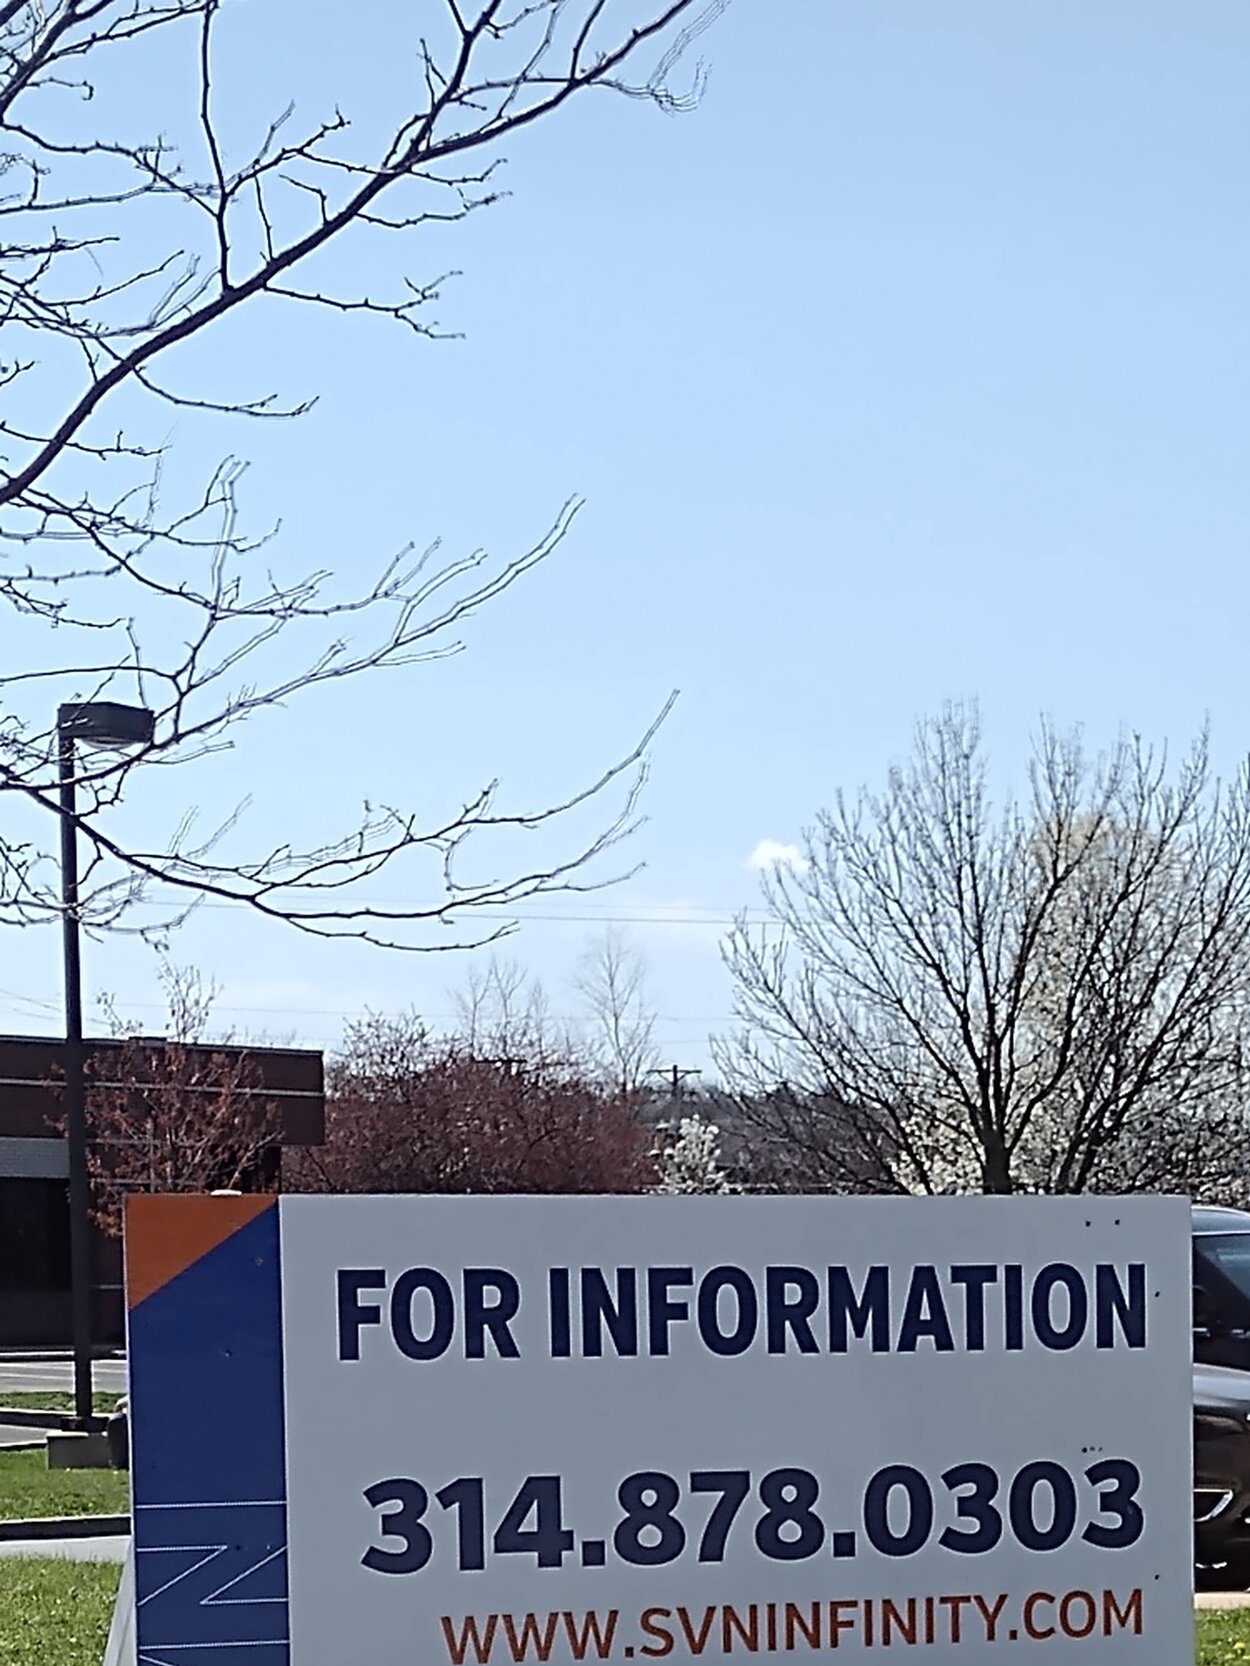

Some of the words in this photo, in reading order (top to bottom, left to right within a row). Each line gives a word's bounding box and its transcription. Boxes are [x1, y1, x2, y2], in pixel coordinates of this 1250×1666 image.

[337, 1267, 521, 1361] FOR
[549, 1262, 1146, 1358] INFORMATION
[360, 1459, 1144, 1575] 314.878.0303
[440, 1587, 1143, 1666] WWW.SVNINFINITY.COM
